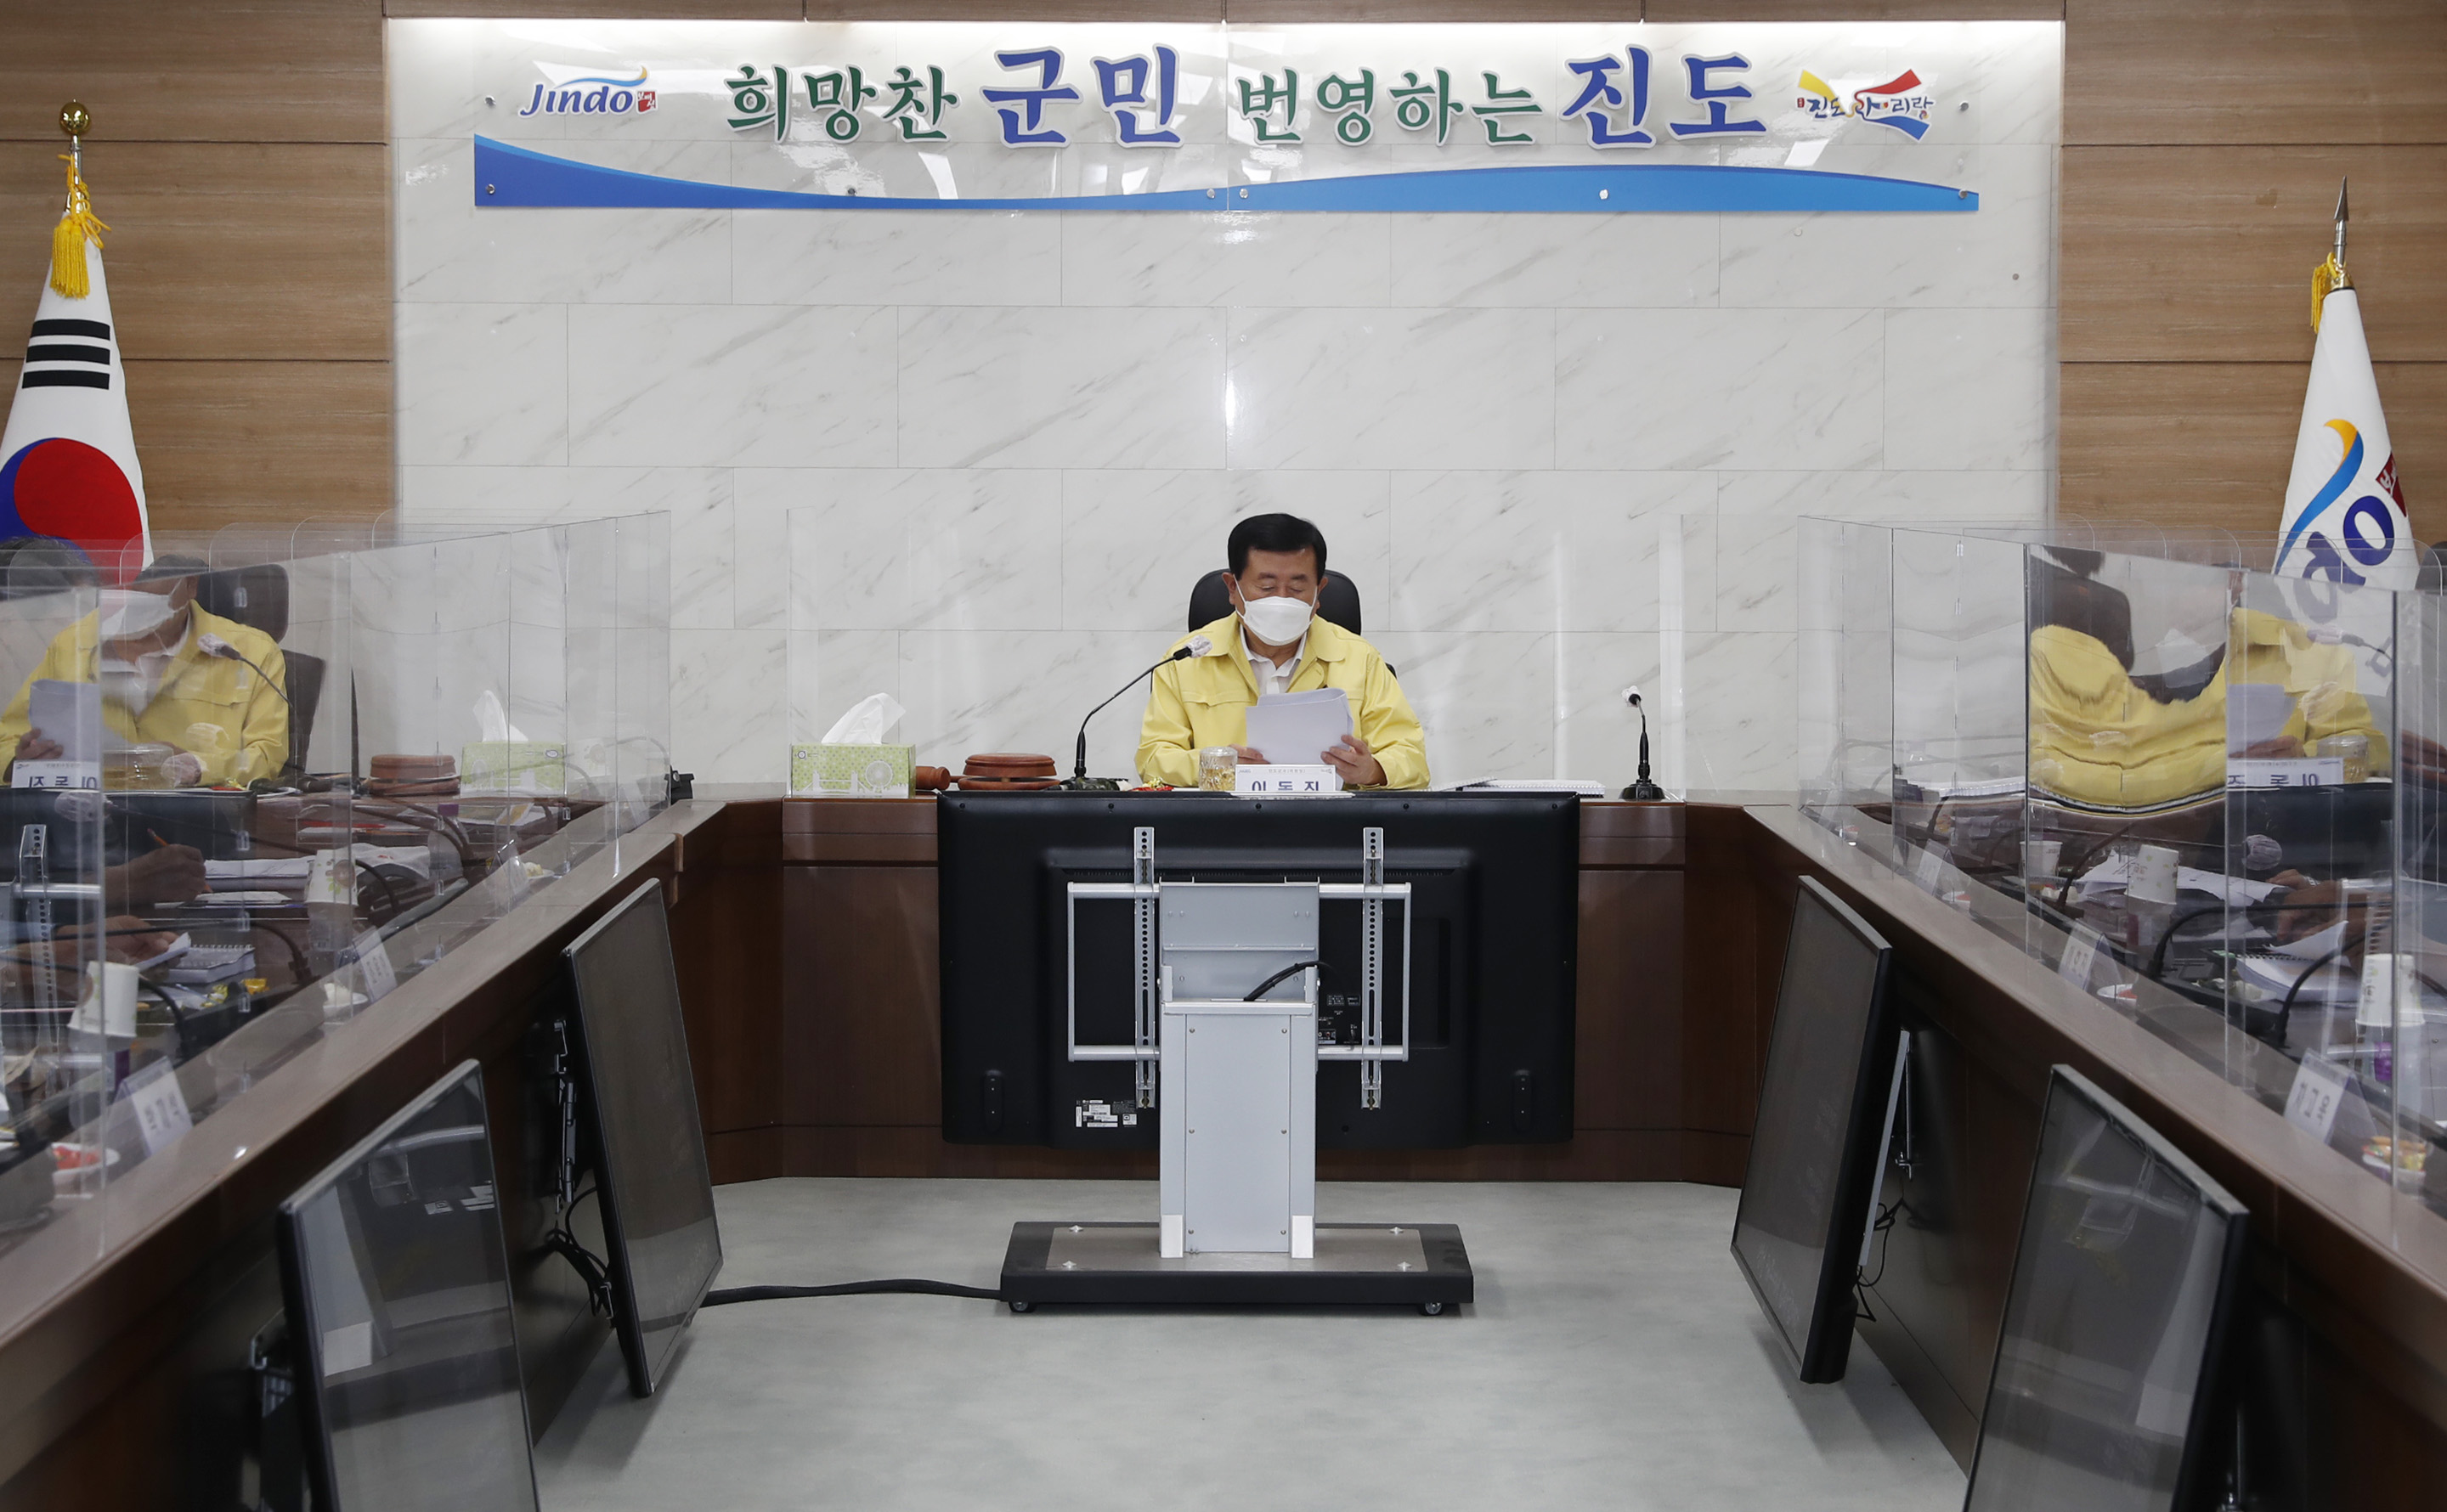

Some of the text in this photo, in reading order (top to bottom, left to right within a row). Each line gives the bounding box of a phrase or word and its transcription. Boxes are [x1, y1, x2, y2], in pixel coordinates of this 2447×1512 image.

[520, 84, 633, 116] Jindo
[726, 44, 1766, 146] 희망찬 군민 번영하는 진도
